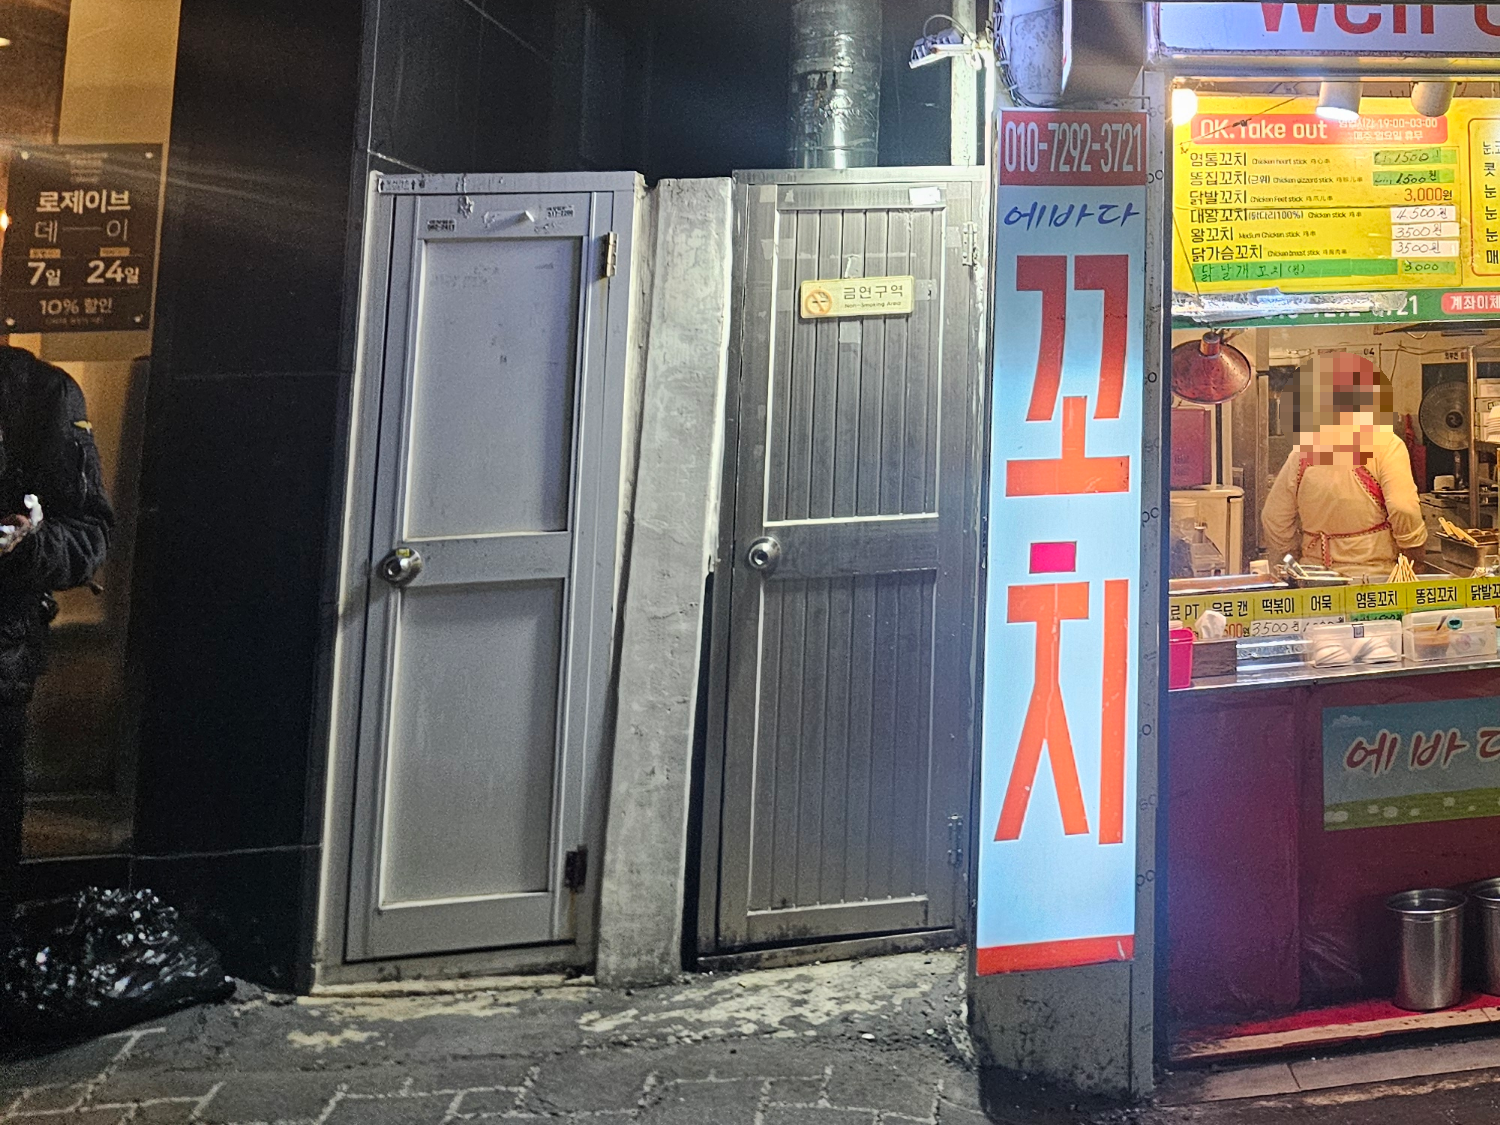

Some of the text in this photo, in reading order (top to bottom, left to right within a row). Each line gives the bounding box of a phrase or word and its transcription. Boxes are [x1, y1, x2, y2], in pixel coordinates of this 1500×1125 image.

[1293, 120, 1327, 139] out
[1004, 121, 1142, 172] 010-7292-3721
[1190, 152, 1247, 167] 염통꼬치
[36, 189, 131, 214] 로제이브
[1190, 190, 1247, 205] 닭발꼬치
[1404, 188, 1452, 202] 3,000원
[1004, 201, 1140, 231] 에바다
[1191, 226, 1233, 243] 왕꼬치
[1192, 244, 1263, 263] 닭가슴꼬치
[28, 259, 139, 287] 7일 24일
[843, 284, 903, 300] 금연구역
[39, 298, 113, 315] 10% 할인
[994, 255, 1130, 845] 꼬치
[1311, 595, 1333, 611] 어묵
[1356, 589, 1398, 608] 염통꼬치
[1415, 586, 1458, 604] 똥집꼬치
[1238, 599, 1248, 617] 캔
[1262, 597, 1295, 614] 떡볶이
